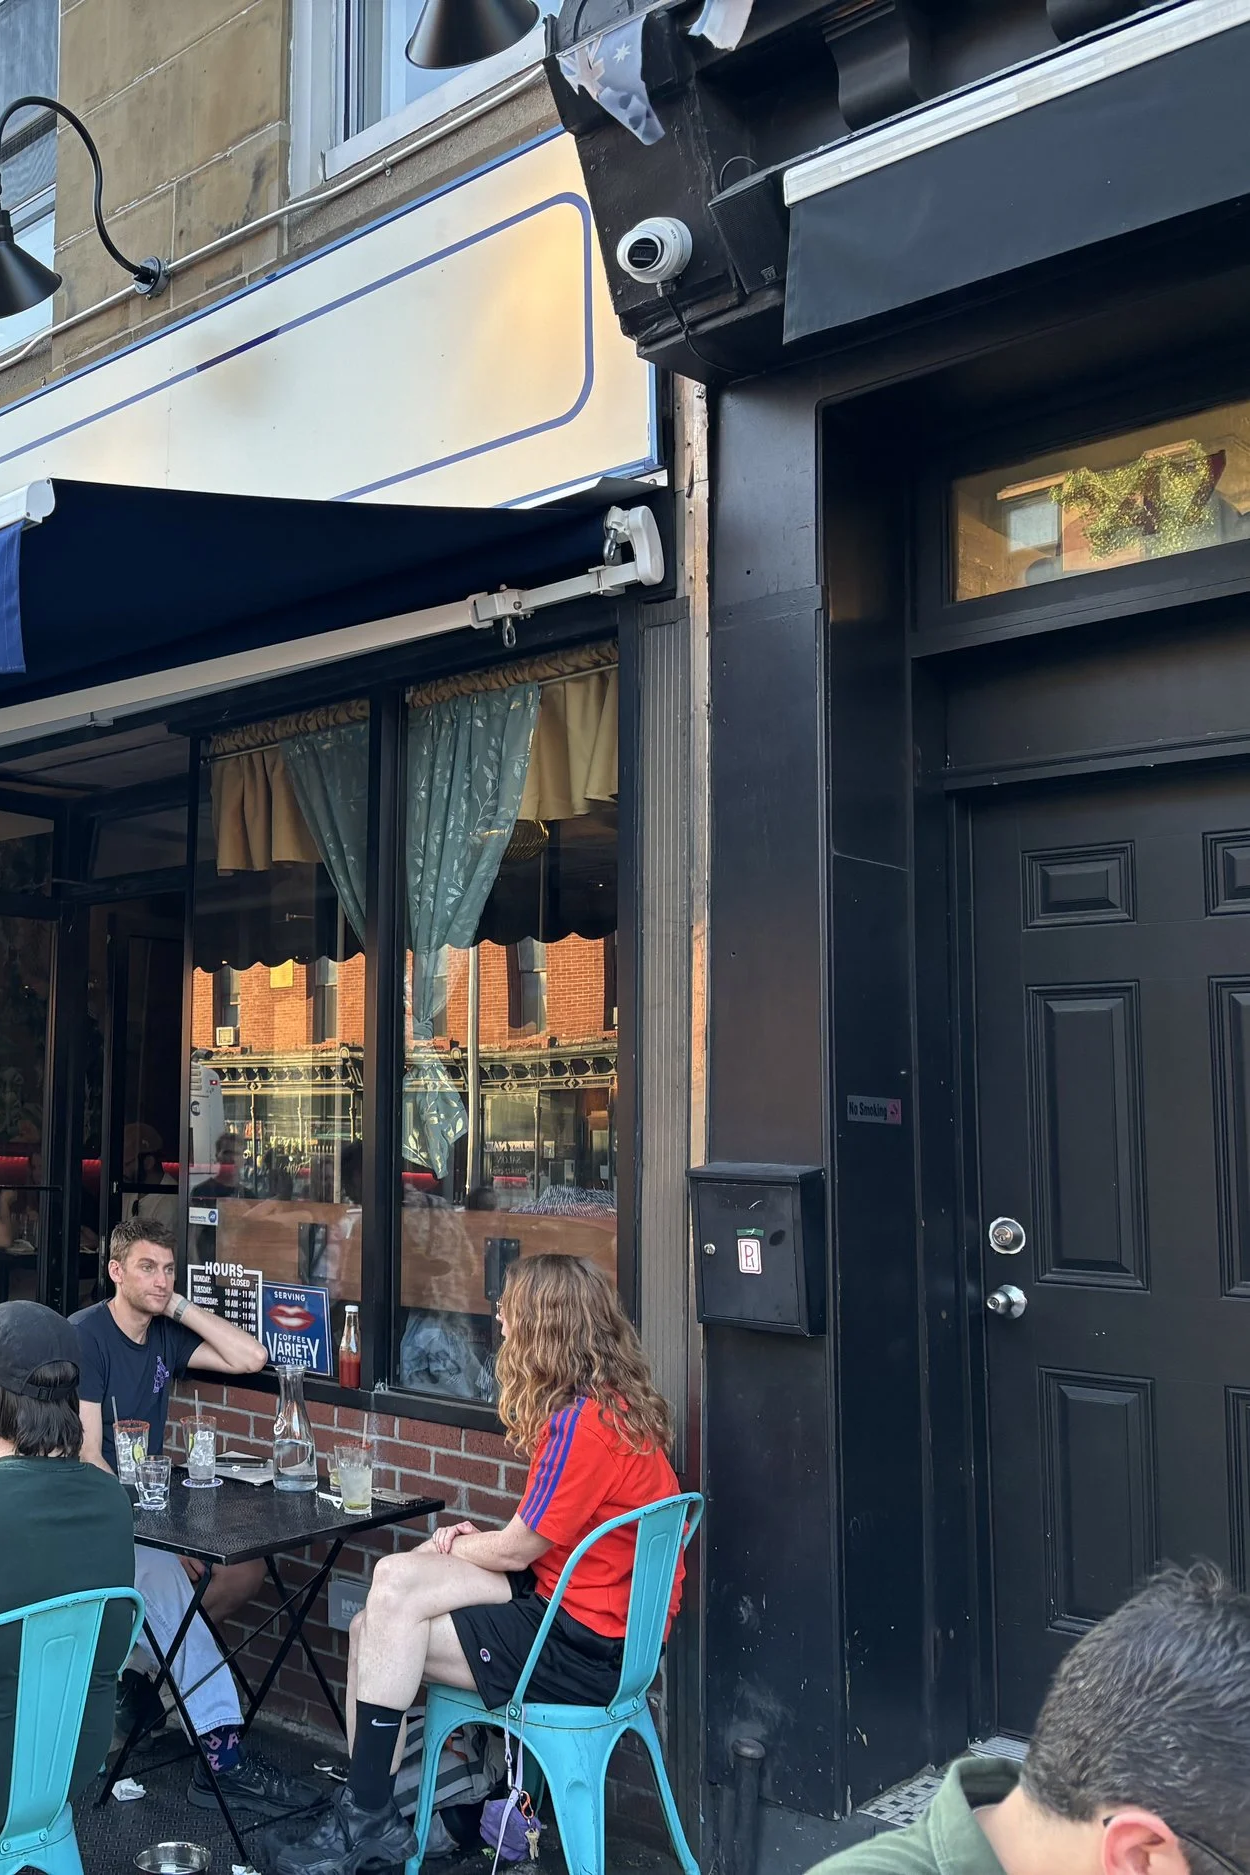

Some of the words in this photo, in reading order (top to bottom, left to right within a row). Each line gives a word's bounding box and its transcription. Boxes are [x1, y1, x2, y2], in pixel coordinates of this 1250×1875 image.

[849, 1101, 858, 1116] No
[859, 1102, 887, 1120] Smoking
[205, 1261, 244, 1278] HOURS
[230, 1278, 251, 1287] CLOSED
[248, 1290, 256, 1298] PM
[274, 1291, 306, 1302] SERVING
[248, 1302, 256, 1310] PM
[248, 1312, 256, 1320] PM
[248, 1324, 256, 1332] PM
[278, 1333, 306, 1344] COFFEE
[266, 1331, 319, 1369] VARIETY
[278, 1355, 311, 1368] ROASTERS
